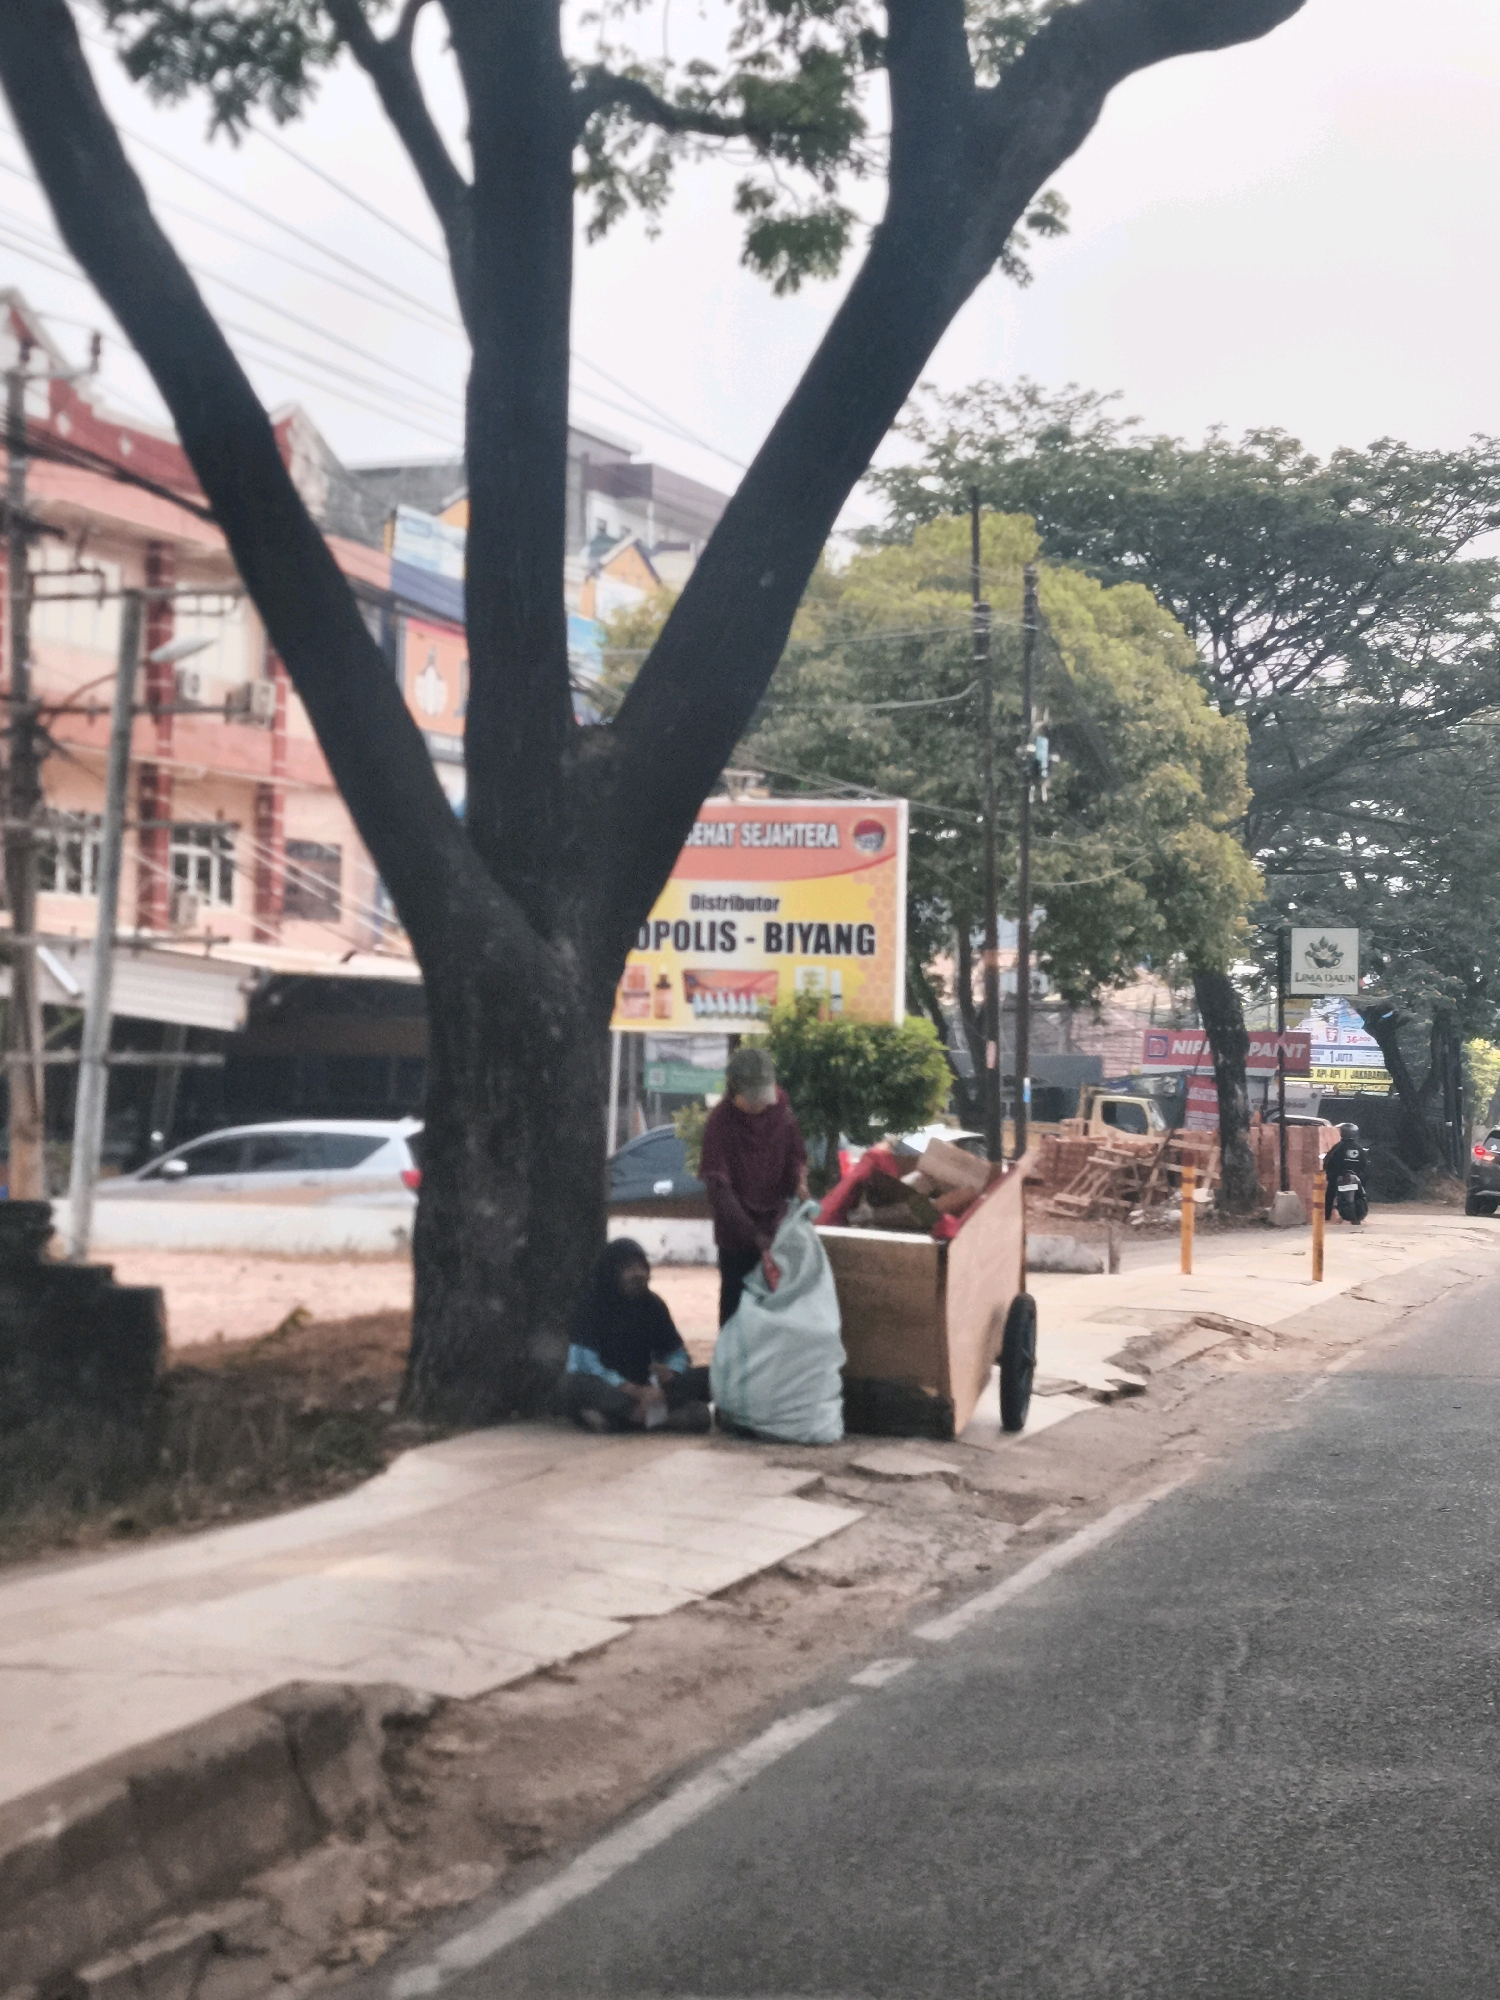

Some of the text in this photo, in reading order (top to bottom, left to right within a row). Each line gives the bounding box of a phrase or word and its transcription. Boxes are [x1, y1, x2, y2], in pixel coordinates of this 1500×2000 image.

[740, 823, 840, 848] SEJAHTERA
[690, 893, 780, 912] Distributor
[764, 921, 875, 955] BIYANG
